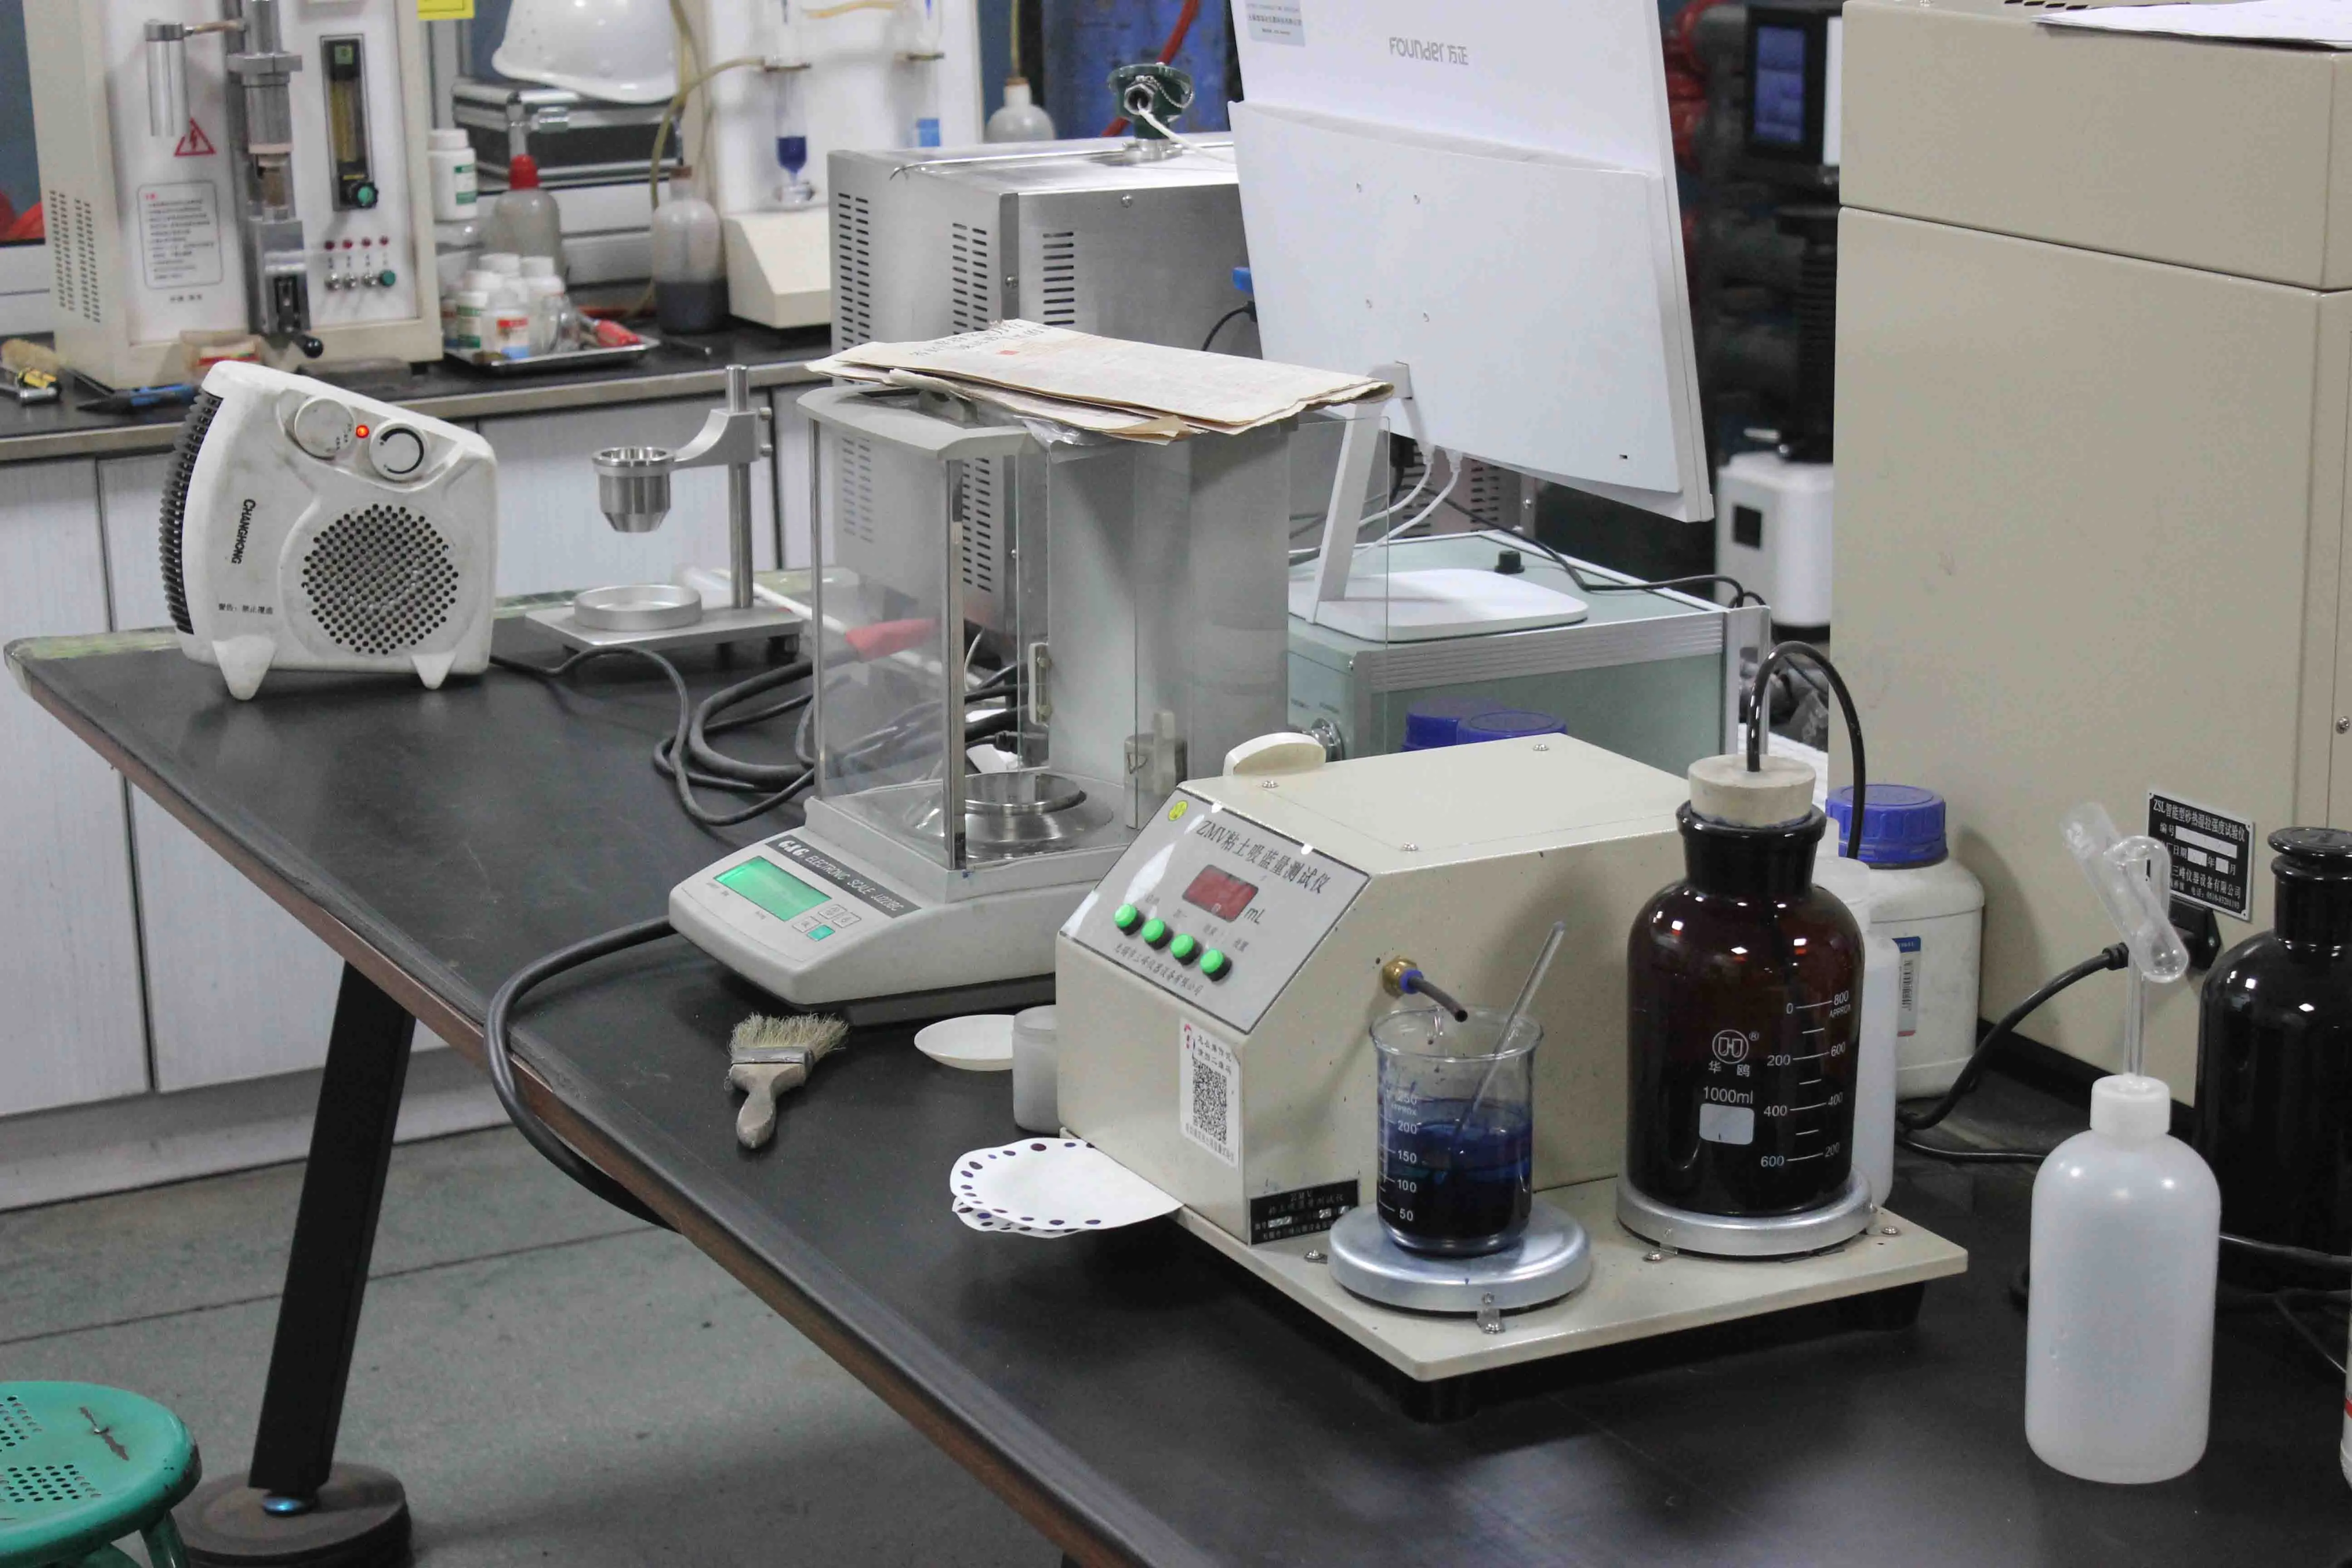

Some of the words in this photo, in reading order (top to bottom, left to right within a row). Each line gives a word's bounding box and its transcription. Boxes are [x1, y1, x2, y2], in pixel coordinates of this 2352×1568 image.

[1447, 44, 1469, 65] 方正
[231, 499, 256, 564] CHANGHONG
[805, 855, 851, 880] ELECTRONIC
[847, 879, 876, 895] SCALE
[2229, 863, 2236, 876] 月
[1243, 907, 1265, 925] mL
[1834, 990, 1849, 1005] 800
[1787, 1003, 1793, 1014] 0
[1831, 1042, 1846, 1057] 600
[1767, 1054, 1791, 1067] 200
[1703, 1086, 1754, 1104] 1000ml
[1828, 1092, 1843, 1106] 400
[1764, 1106, 1788, 1117] 400
[1398, 1120, 1416, 1134] 200
[1398, 1150, 1417, 1164] 150
[1825, 1142, 1840, 1158] 200
[1761, 1156, 1784, 1167] 600
[1398, 1180, 1417, 1193] 100
[1399, 1208, 1414, 1222] 50
